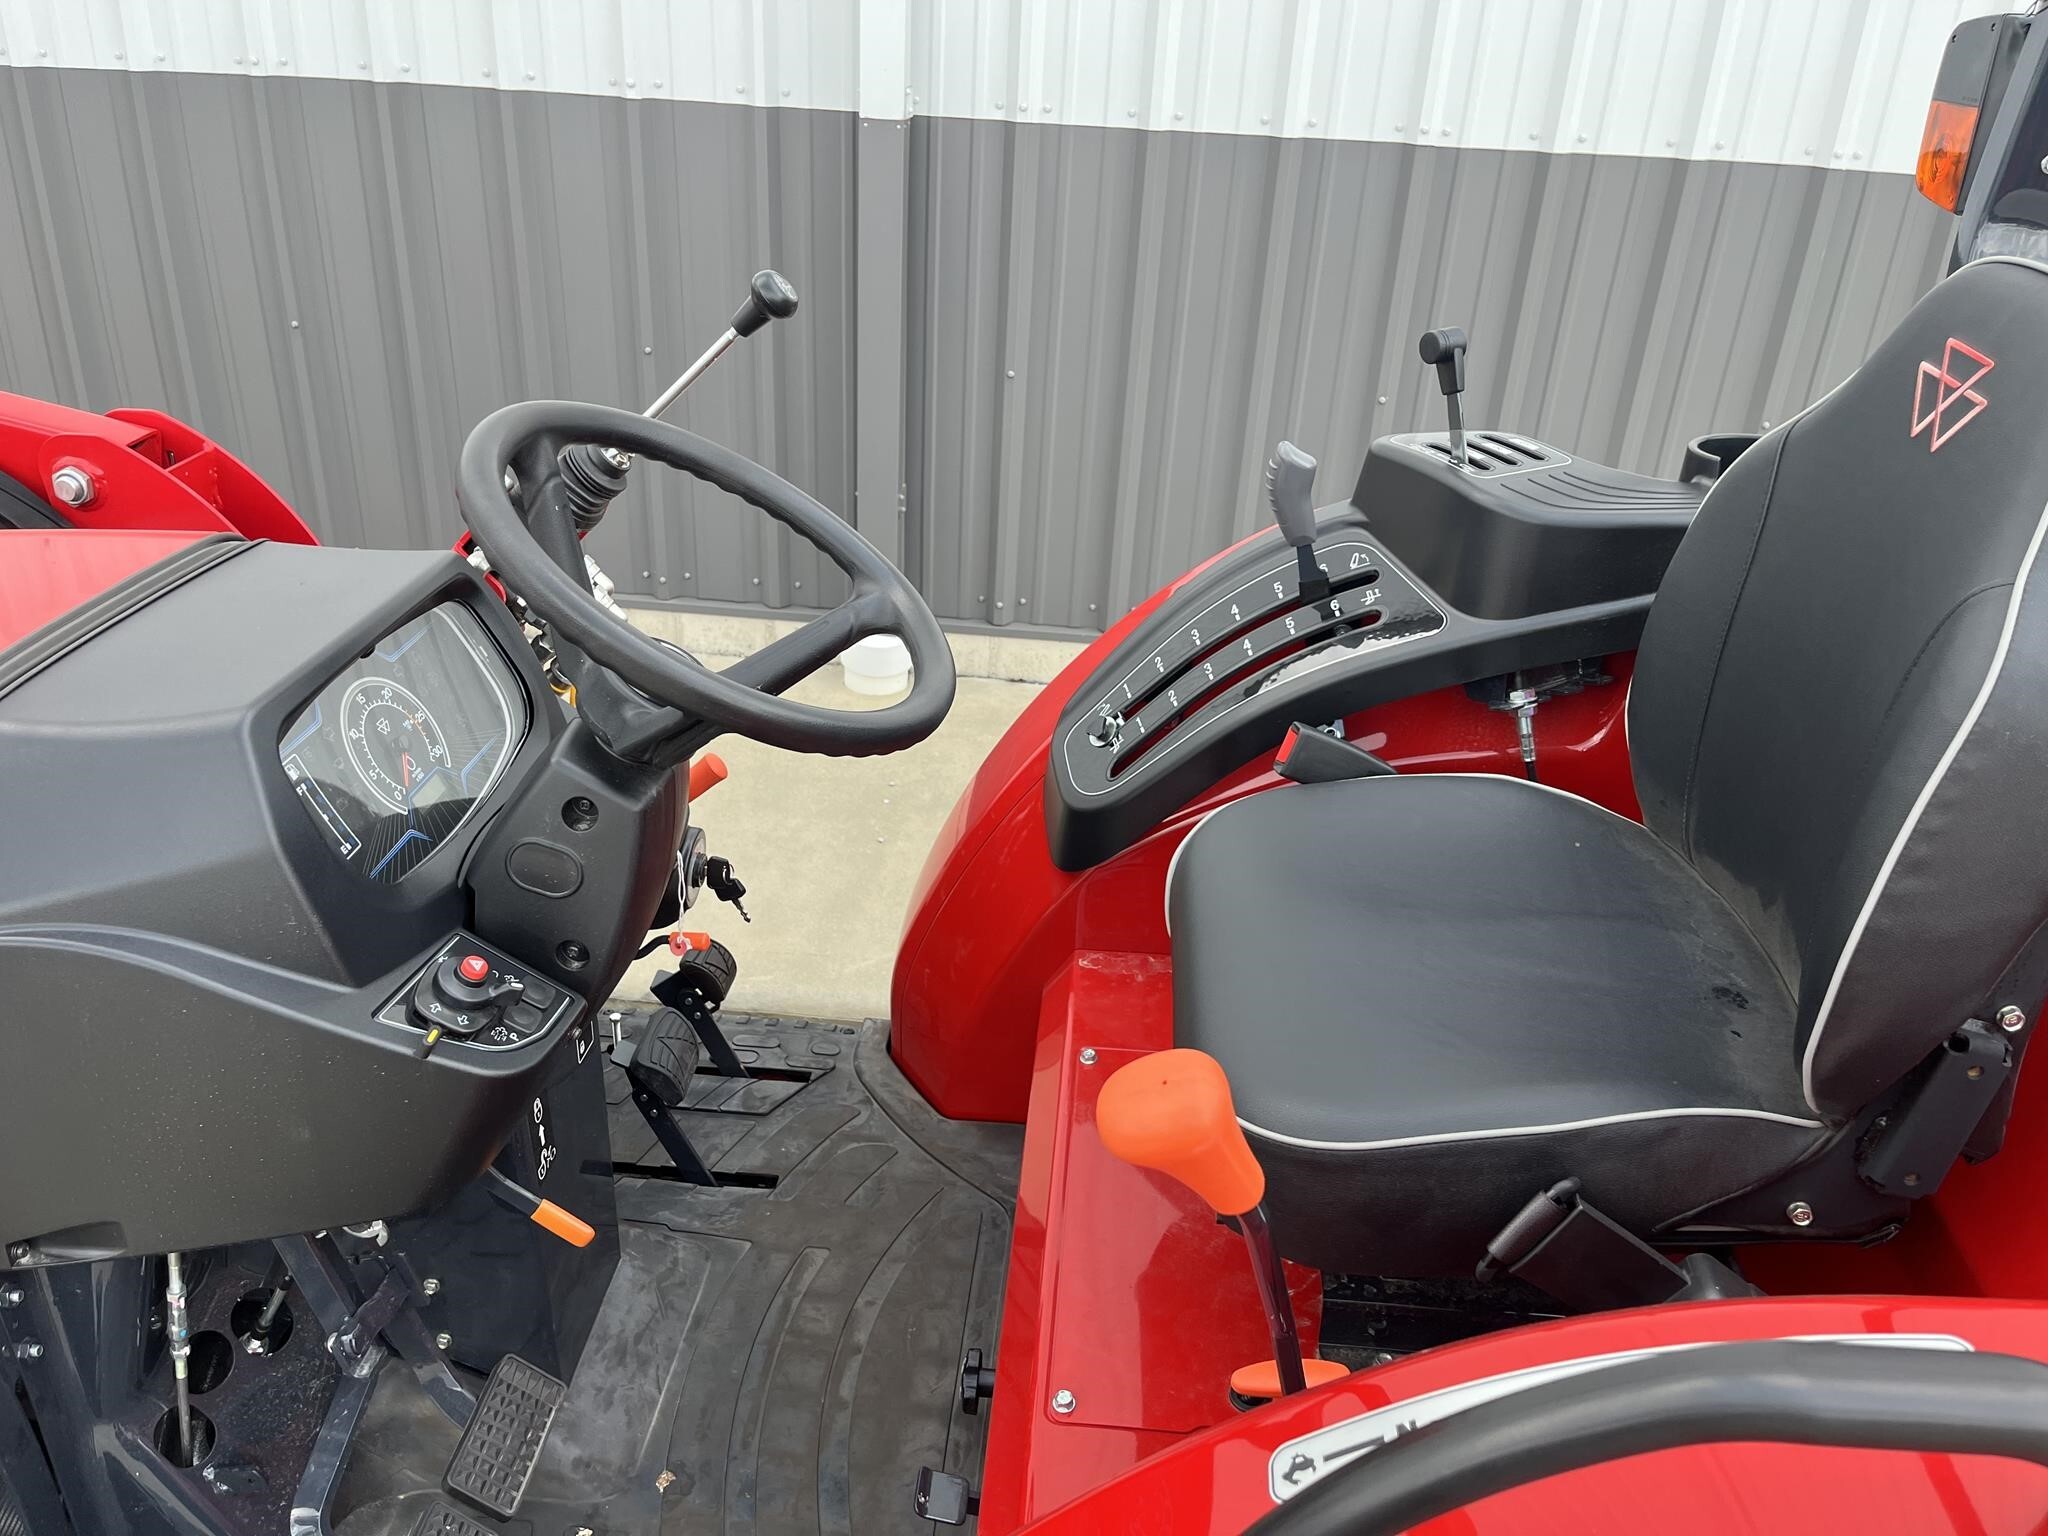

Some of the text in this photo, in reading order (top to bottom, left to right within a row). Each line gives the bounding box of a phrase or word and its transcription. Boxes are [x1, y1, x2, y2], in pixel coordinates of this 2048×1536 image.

[1155, 657, 1163, 668] 2
[1191, 629, 1199, 639] 3
[1231, 604, 1238, 614] 4
[1274, 582, 1282, 592] 5
[1168, 690, 1177, 702] 2
[1204, 663, 1212, 674] 3
[1243, 639, 1251, 649] 4
[1285, 617, 1294, 628] 5
[1330, 600, 1339, 610] 6
[349, 688, 442, 800] 0 5 10 15 20 25 30
